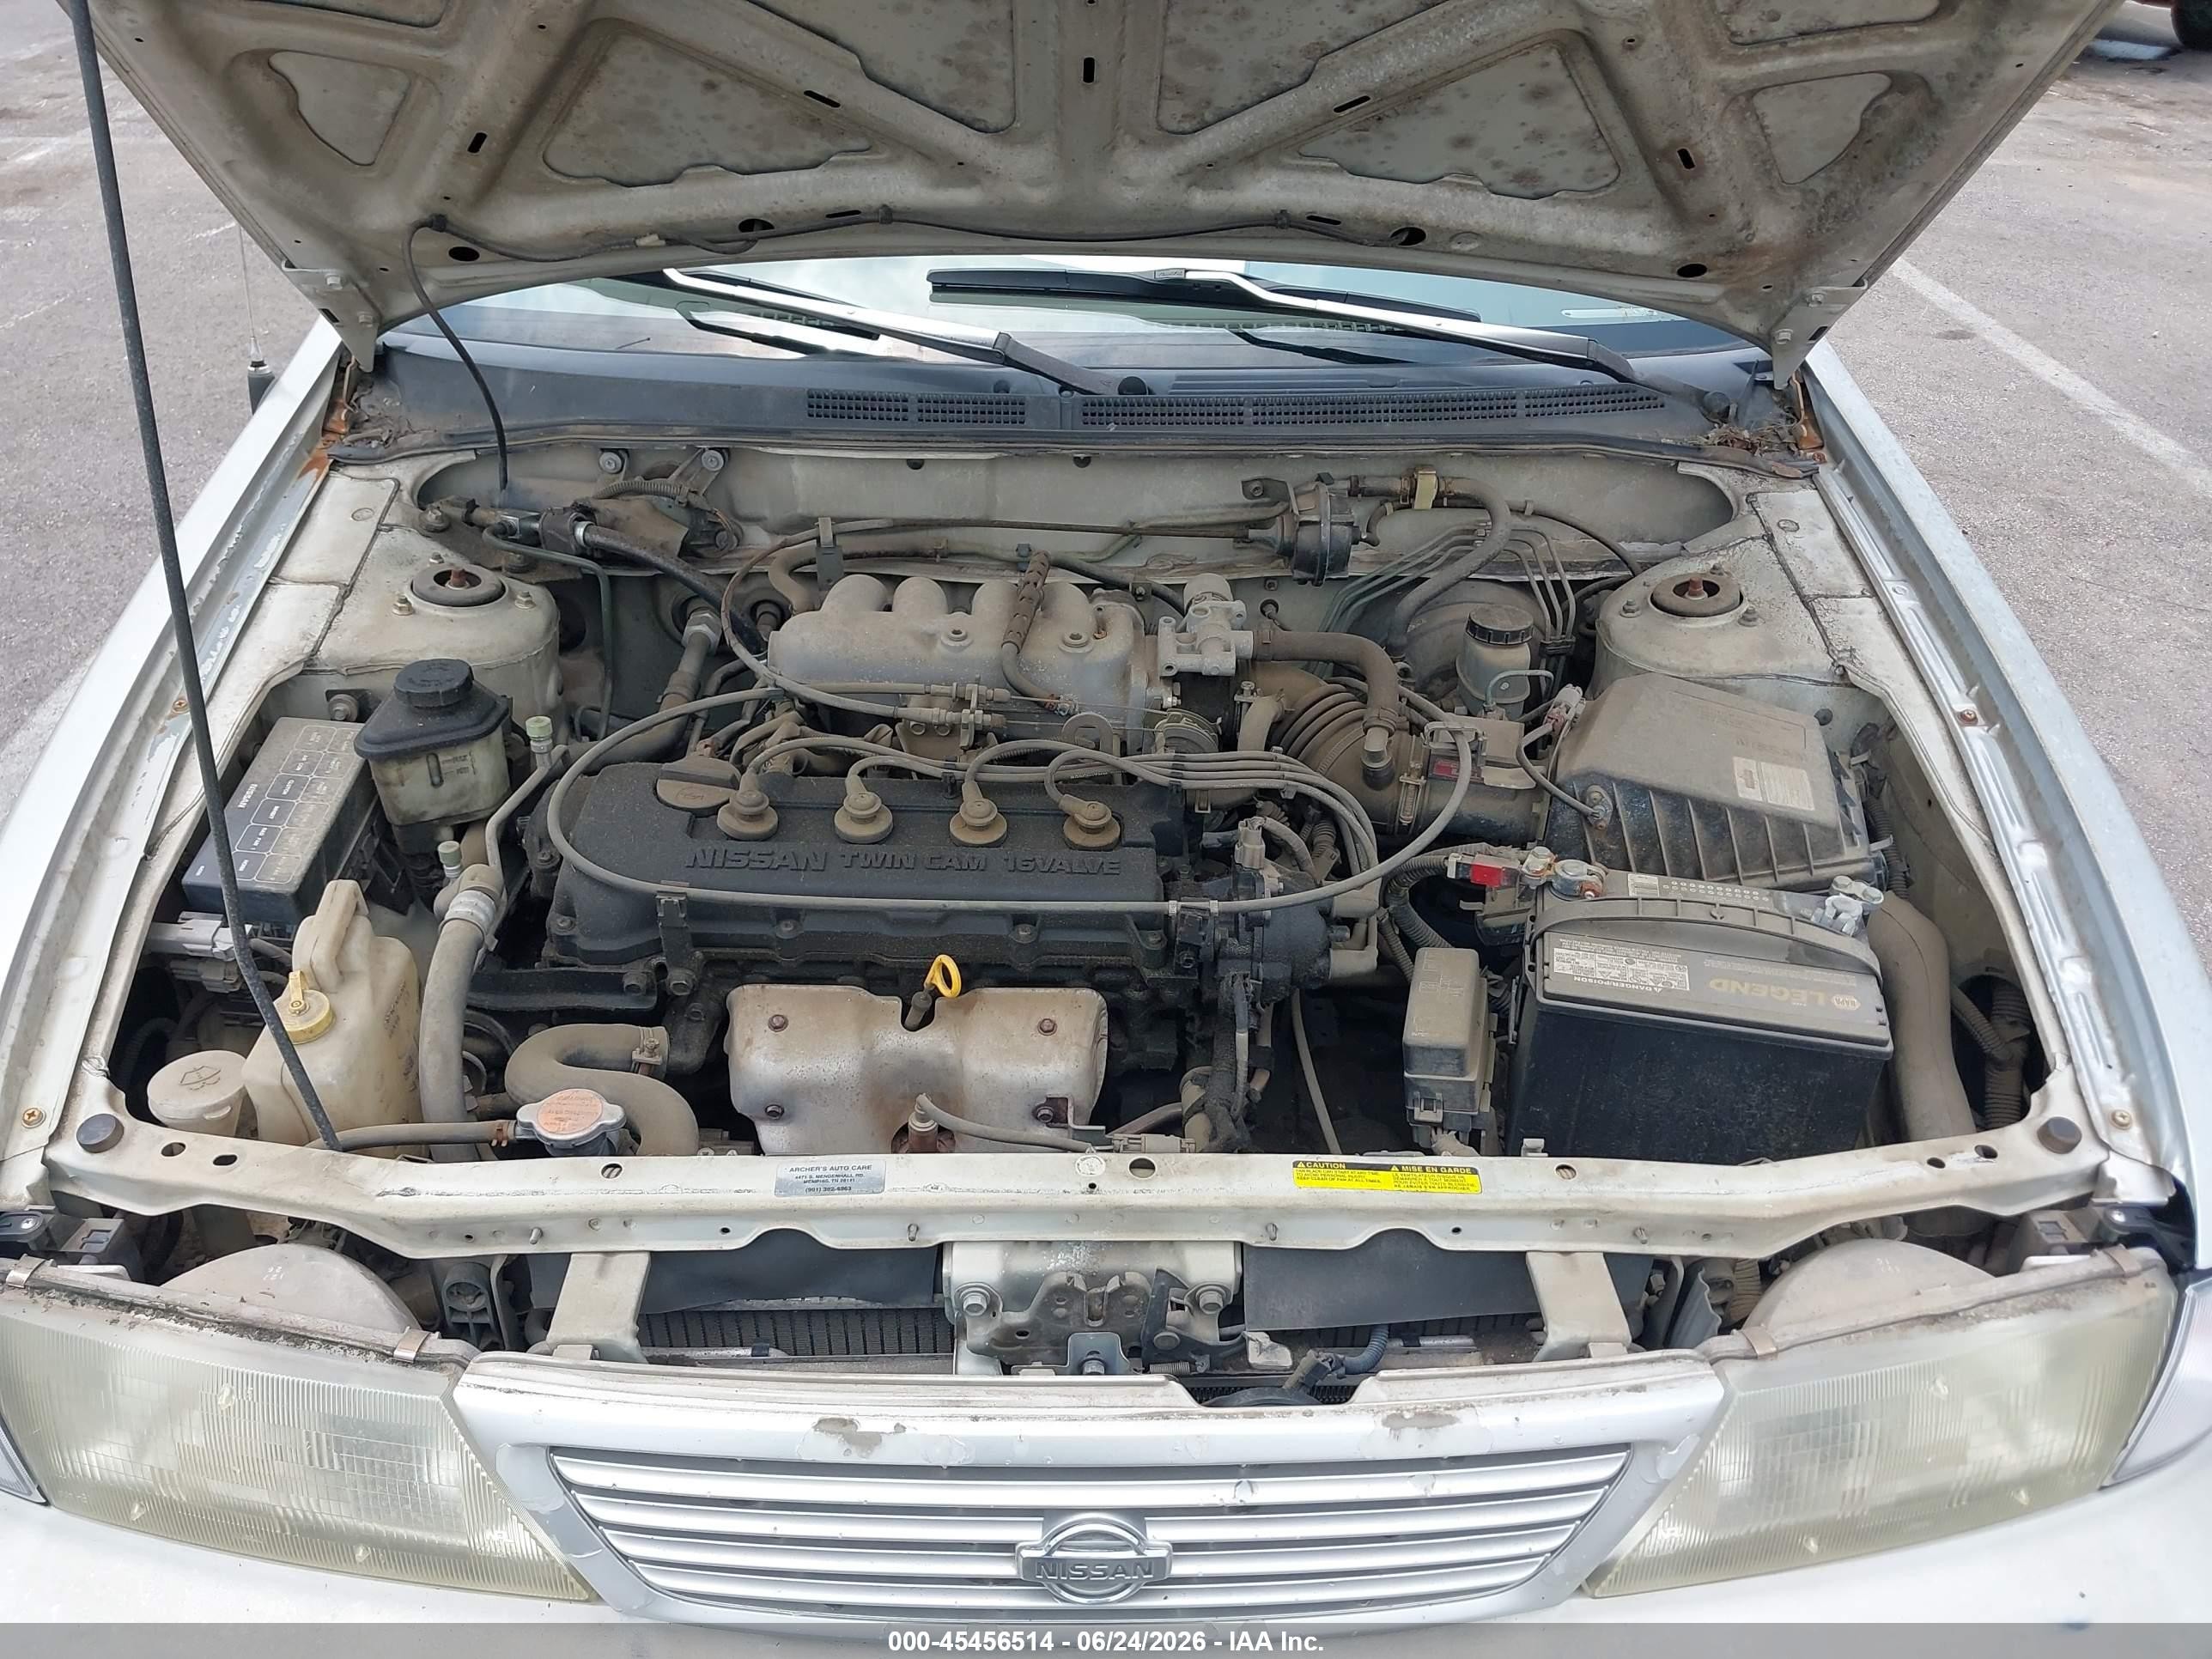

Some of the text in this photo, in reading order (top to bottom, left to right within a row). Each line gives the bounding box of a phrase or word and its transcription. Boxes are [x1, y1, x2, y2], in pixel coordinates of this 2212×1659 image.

[237, 783, 258, 809] NISSAN
[685, 848, 1121, 876] NISSAN TWIN CAM 16VALVE
[1709, 978, 1828, 1005] LEGEND
[1036, 1560, 1154, 1580] NISSAN
